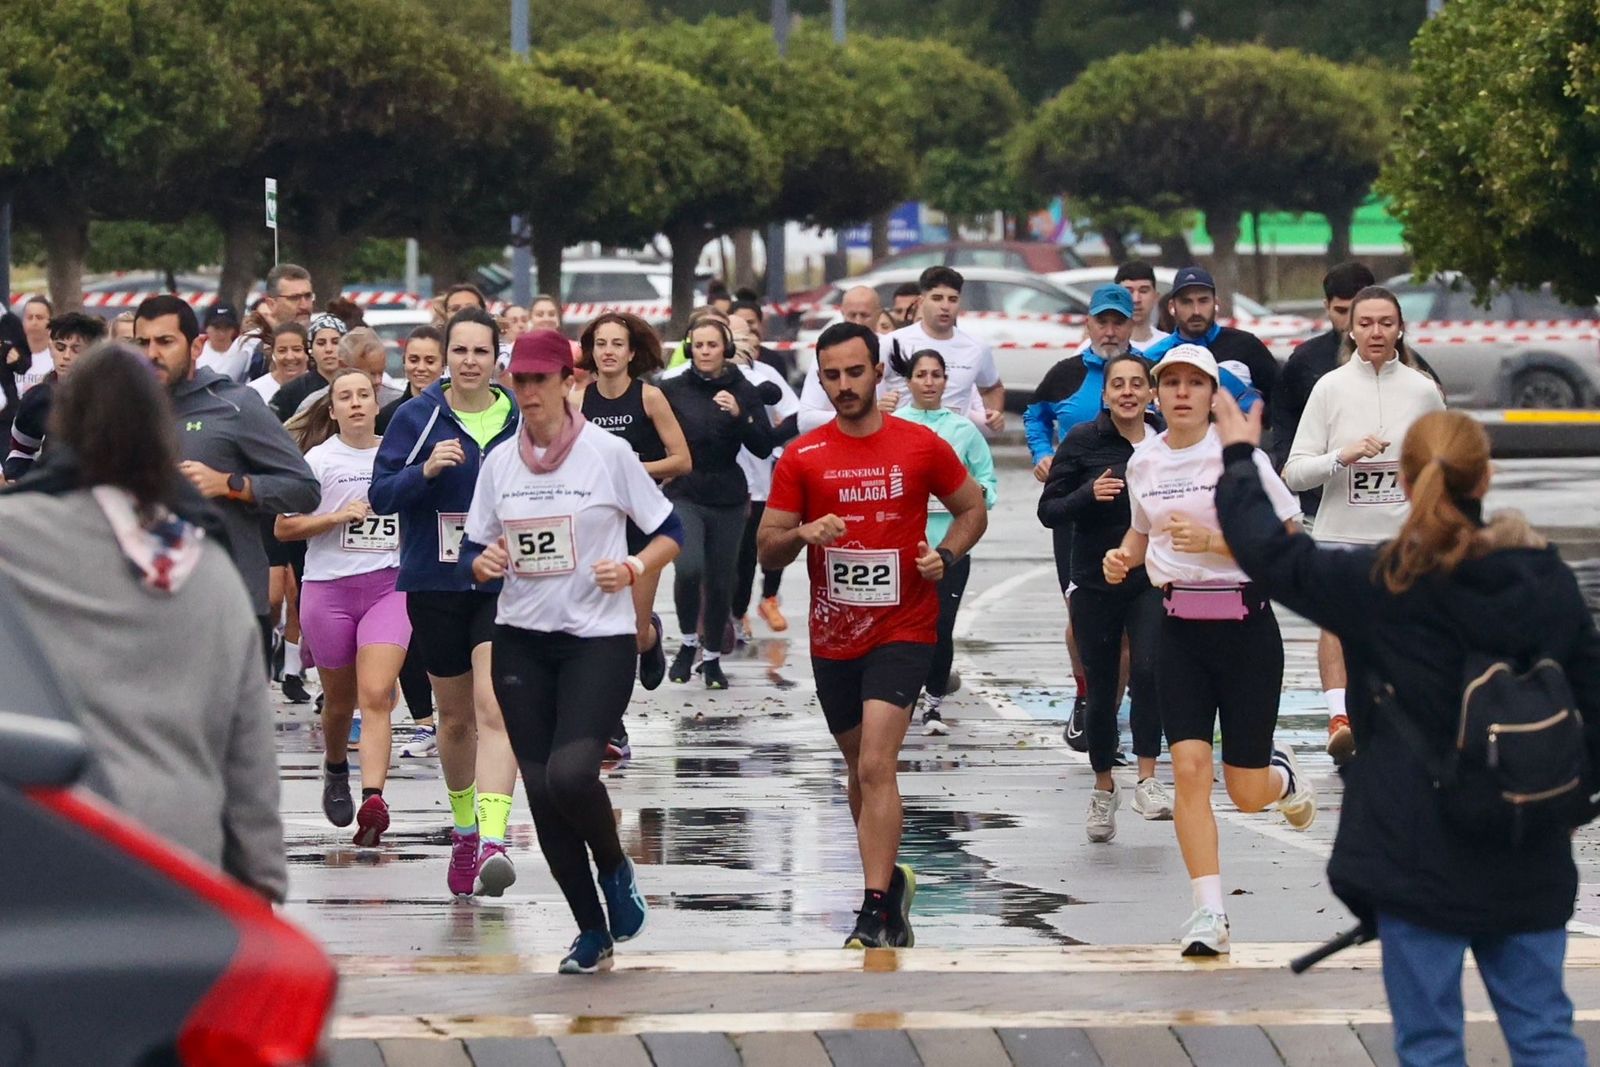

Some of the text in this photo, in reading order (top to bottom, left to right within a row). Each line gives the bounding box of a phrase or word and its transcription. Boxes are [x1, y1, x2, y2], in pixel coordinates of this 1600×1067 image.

[592, 414, 633, 426] OYSHO
[837, 467, 885, 479] GENERALI
[1354, 471, 1399, 490] 277
[839, 486, 887, 503] MÁLAGA
[348, 518, 395, 536] 275
[518, 531, 556, 555] 52
[833, 563, 890, 585] 222
